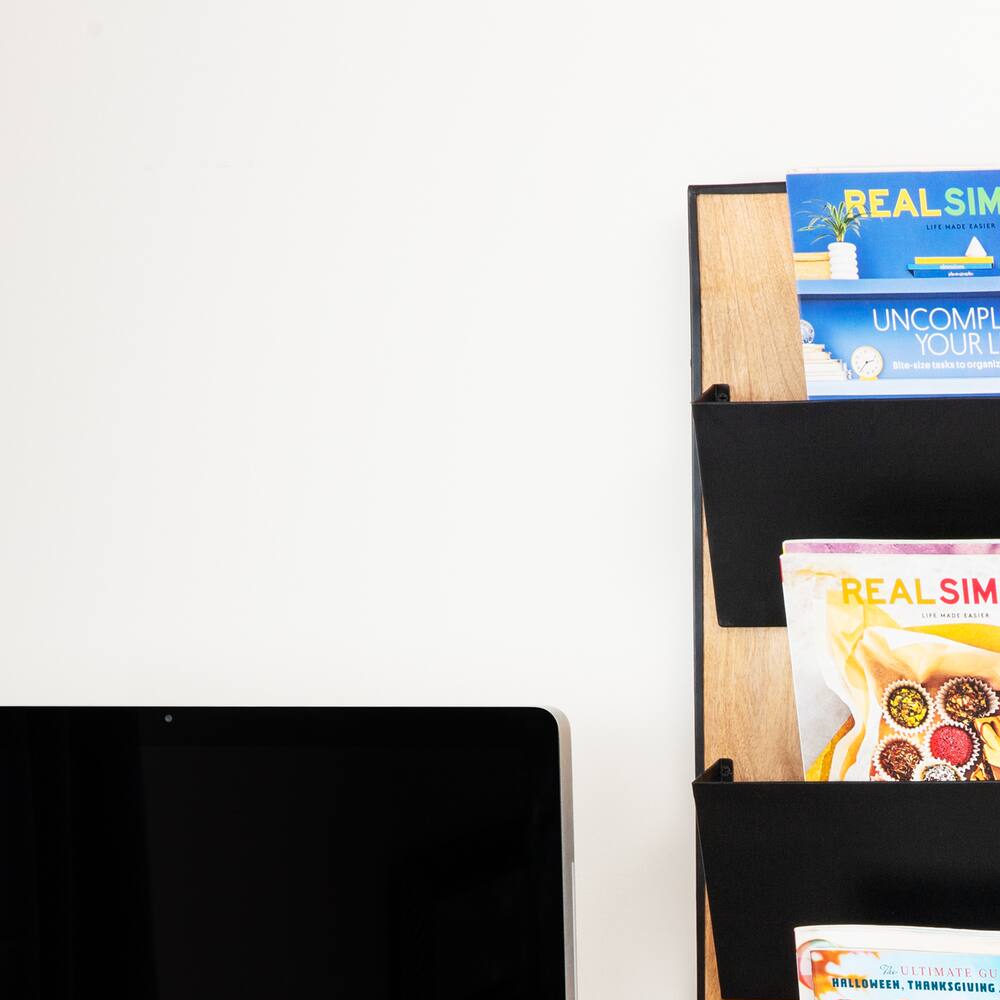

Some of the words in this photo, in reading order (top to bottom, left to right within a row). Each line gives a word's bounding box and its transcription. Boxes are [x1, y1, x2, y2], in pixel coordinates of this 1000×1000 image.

[843, 187, 942, 219] REAL
[944, 223, 966, 231] MADE
[969, 222, 996, 230] EASIER
[914, 332, 984, 356] YOUR
[892, 360, 931, 371] Bite-size
[931, 359, 956, 370] tasks
[956, 360, 965, 369] to
[841, 578, 937, 605] REAL
[900, 966, 972, 978] ULTIMATE
[907, 980, 995, 993] THANKSGIVING
